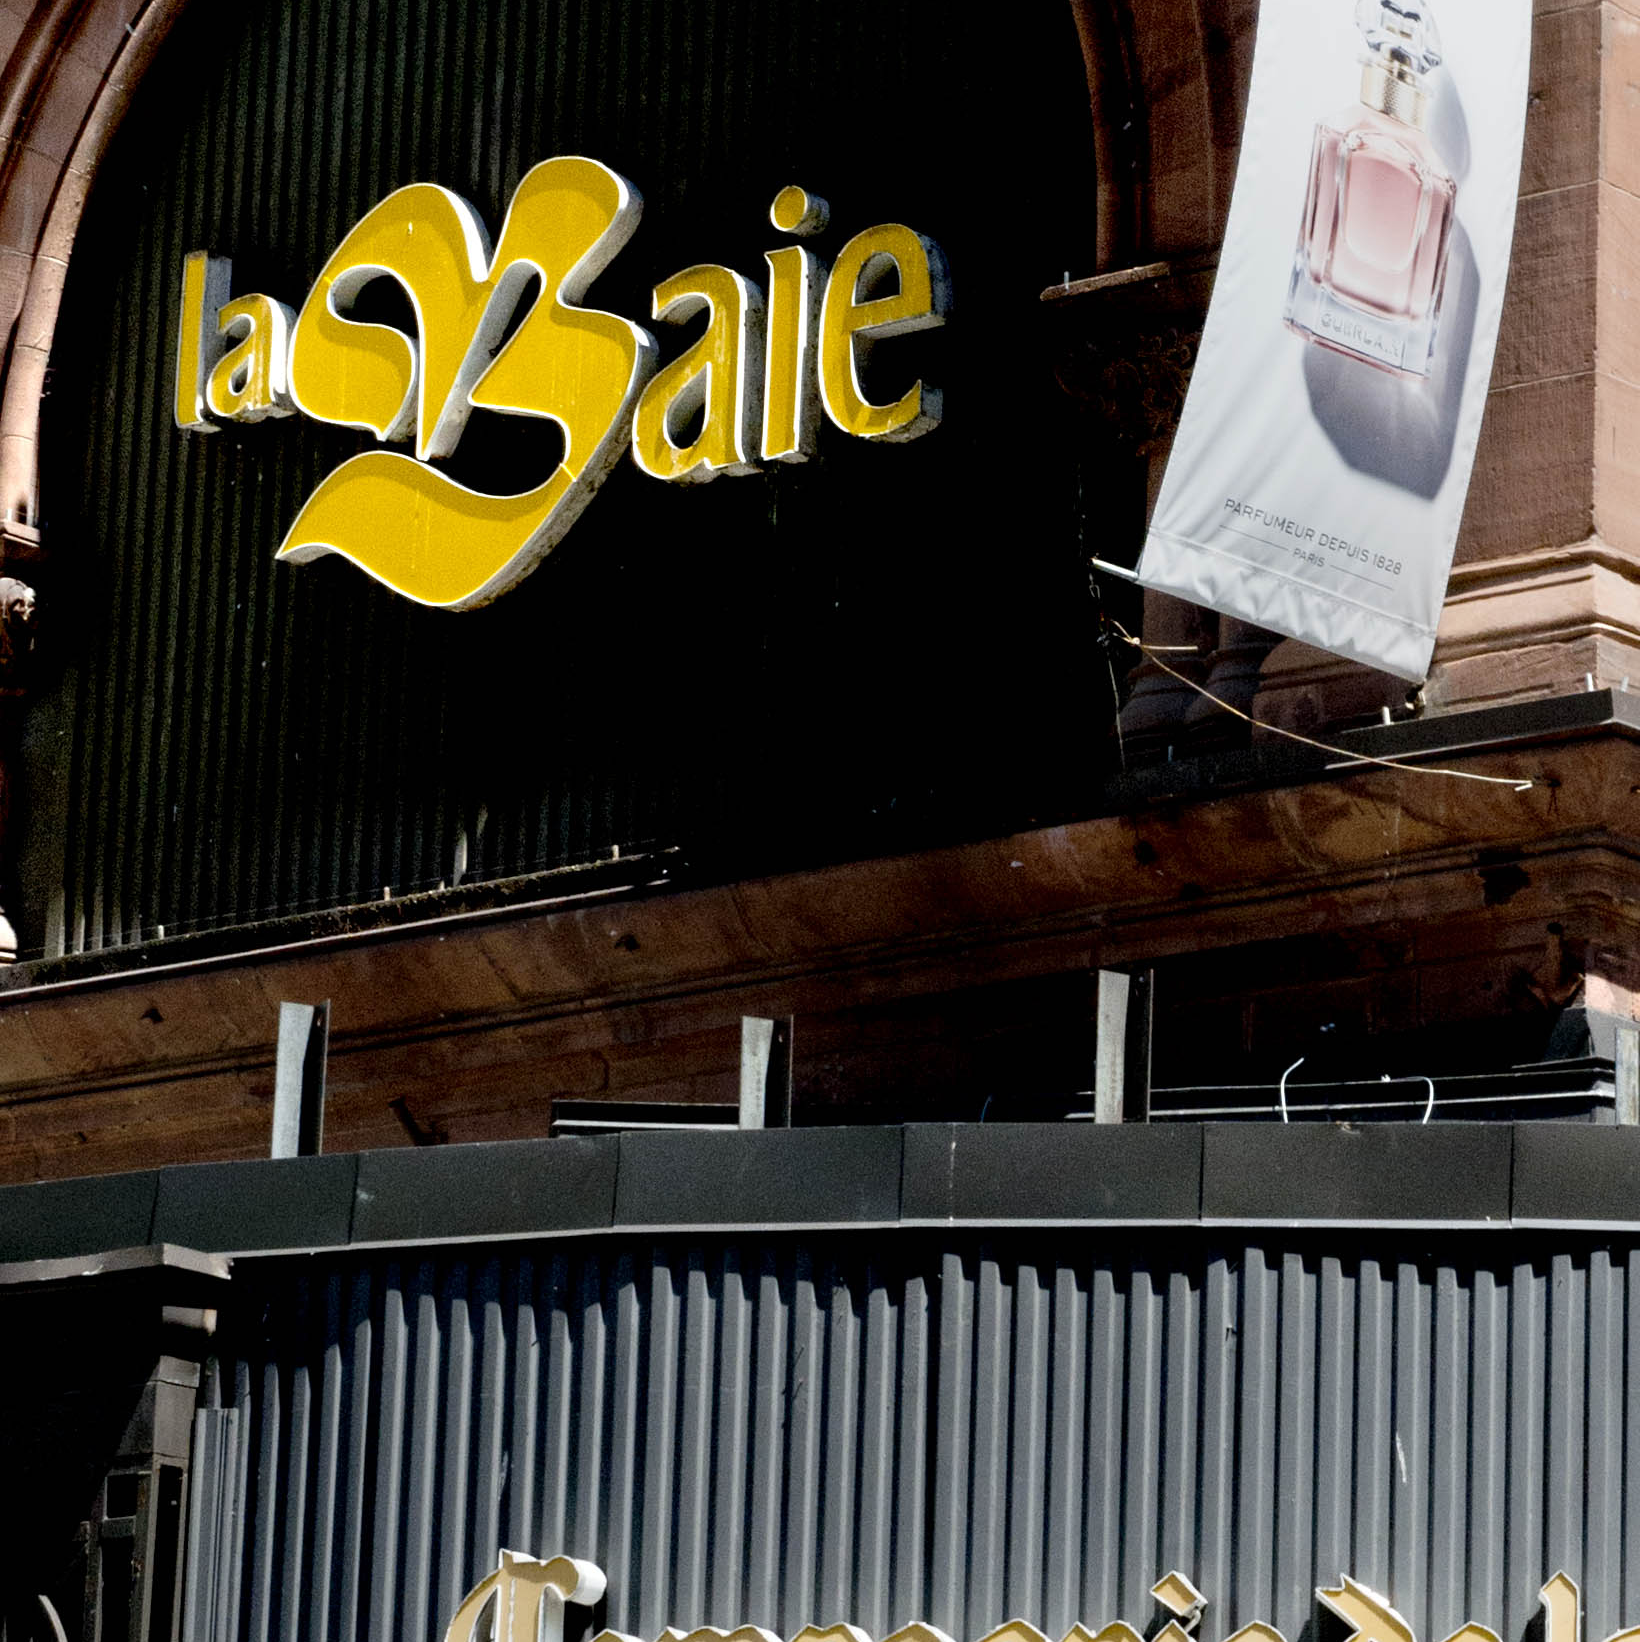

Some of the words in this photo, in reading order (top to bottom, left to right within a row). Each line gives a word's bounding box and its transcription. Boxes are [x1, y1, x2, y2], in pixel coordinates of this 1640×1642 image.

[175, 250, 296, 433] la
[277, 155, 952, 612] Baie
[1224, 498, 1315, 541] PARFUMEUR
[1318, 532, 1369, 562] DEPUIS
[1373, 553, 1402, 575] 1828
[1293, 546, 1325, 568] PARIS
